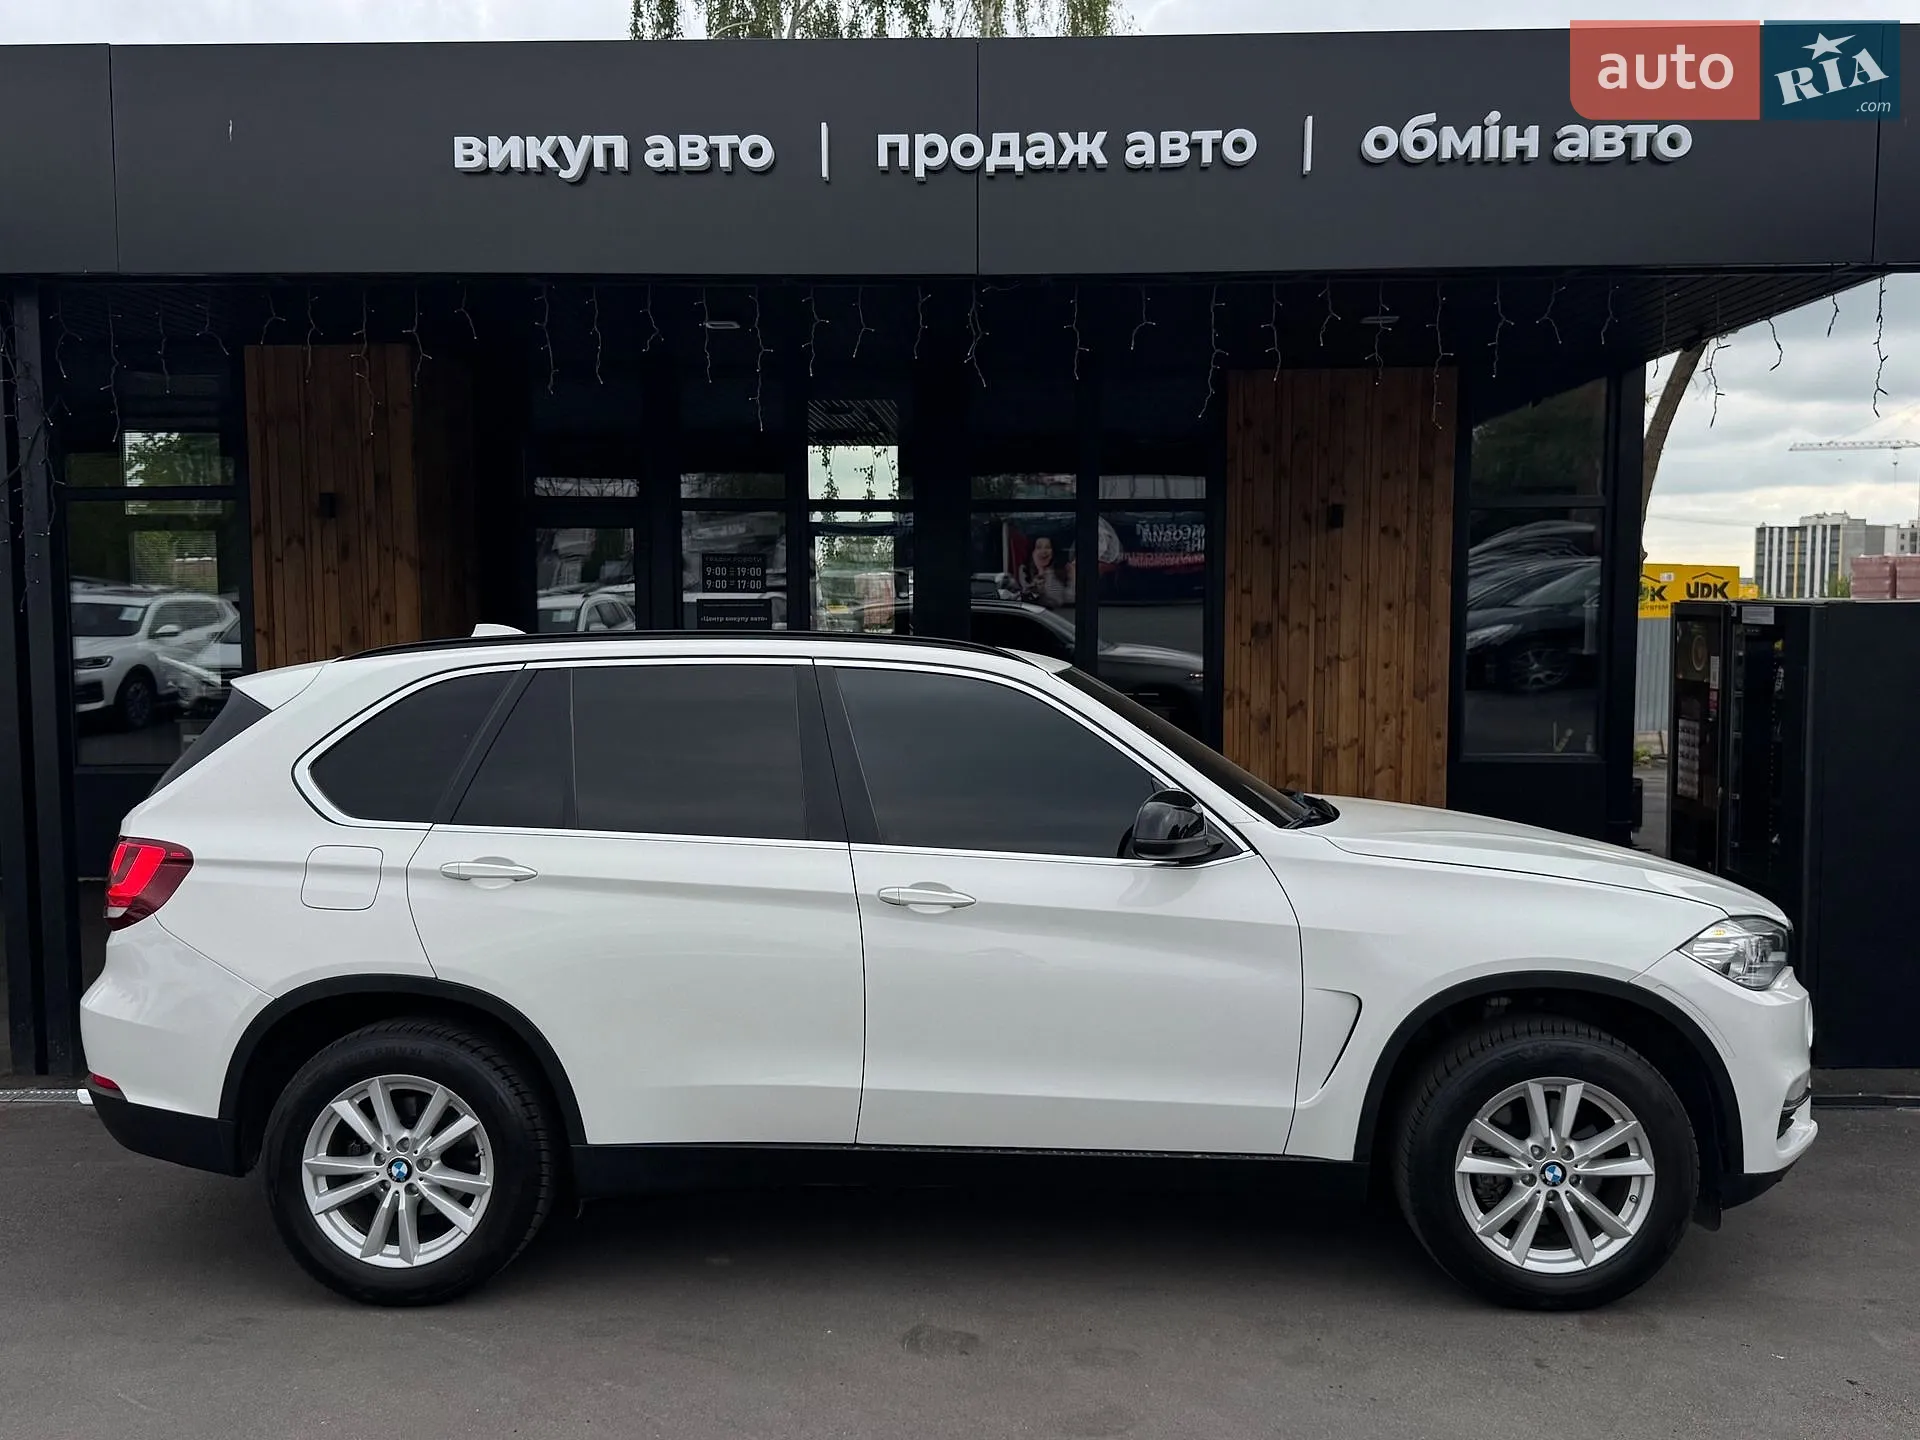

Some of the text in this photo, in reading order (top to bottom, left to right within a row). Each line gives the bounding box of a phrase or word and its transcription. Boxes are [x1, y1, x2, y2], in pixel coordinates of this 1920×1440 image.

[1361, 110, 1692, 163] обмін авто
[453, 134, 775, 182] викуп авто
[877, 128, 1257, 181] продаж авто
[706, 566, 727, 576] 9:00
[737, 566, 762, 577] 19:00
[706, 579, 727, 589] 9:00
[737, 579, 762, 590] 17:00
[1686, 581, 1730, 599] UDK
